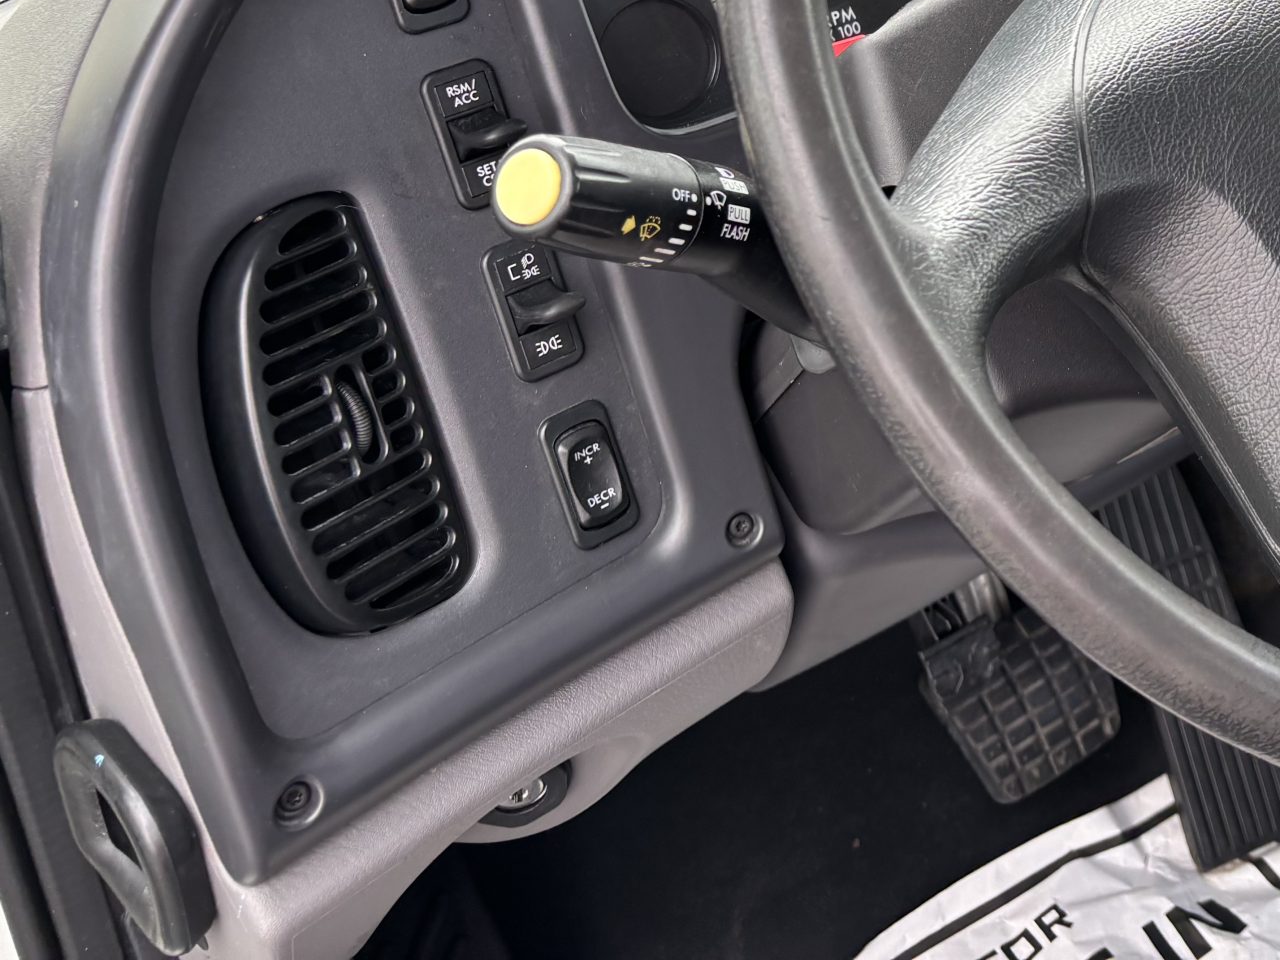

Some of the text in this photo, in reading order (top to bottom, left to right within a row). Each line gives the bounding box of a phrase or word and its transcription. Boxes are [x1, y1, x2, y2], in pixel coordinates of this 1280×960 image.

[838, 21, 861, 39] 100
[445, 78, 476, 98] RSM/
[454, 90, 480, 108] ACC
[672, 188, 691, 202] OFF
[729, 206, 750, 222] PULL
[720, 223, 750, 241] FLASH
[574, 442, 601, 462] INCR
[587, 487, 616, 508] DECR
[976, 904, 1074, 960] OR
